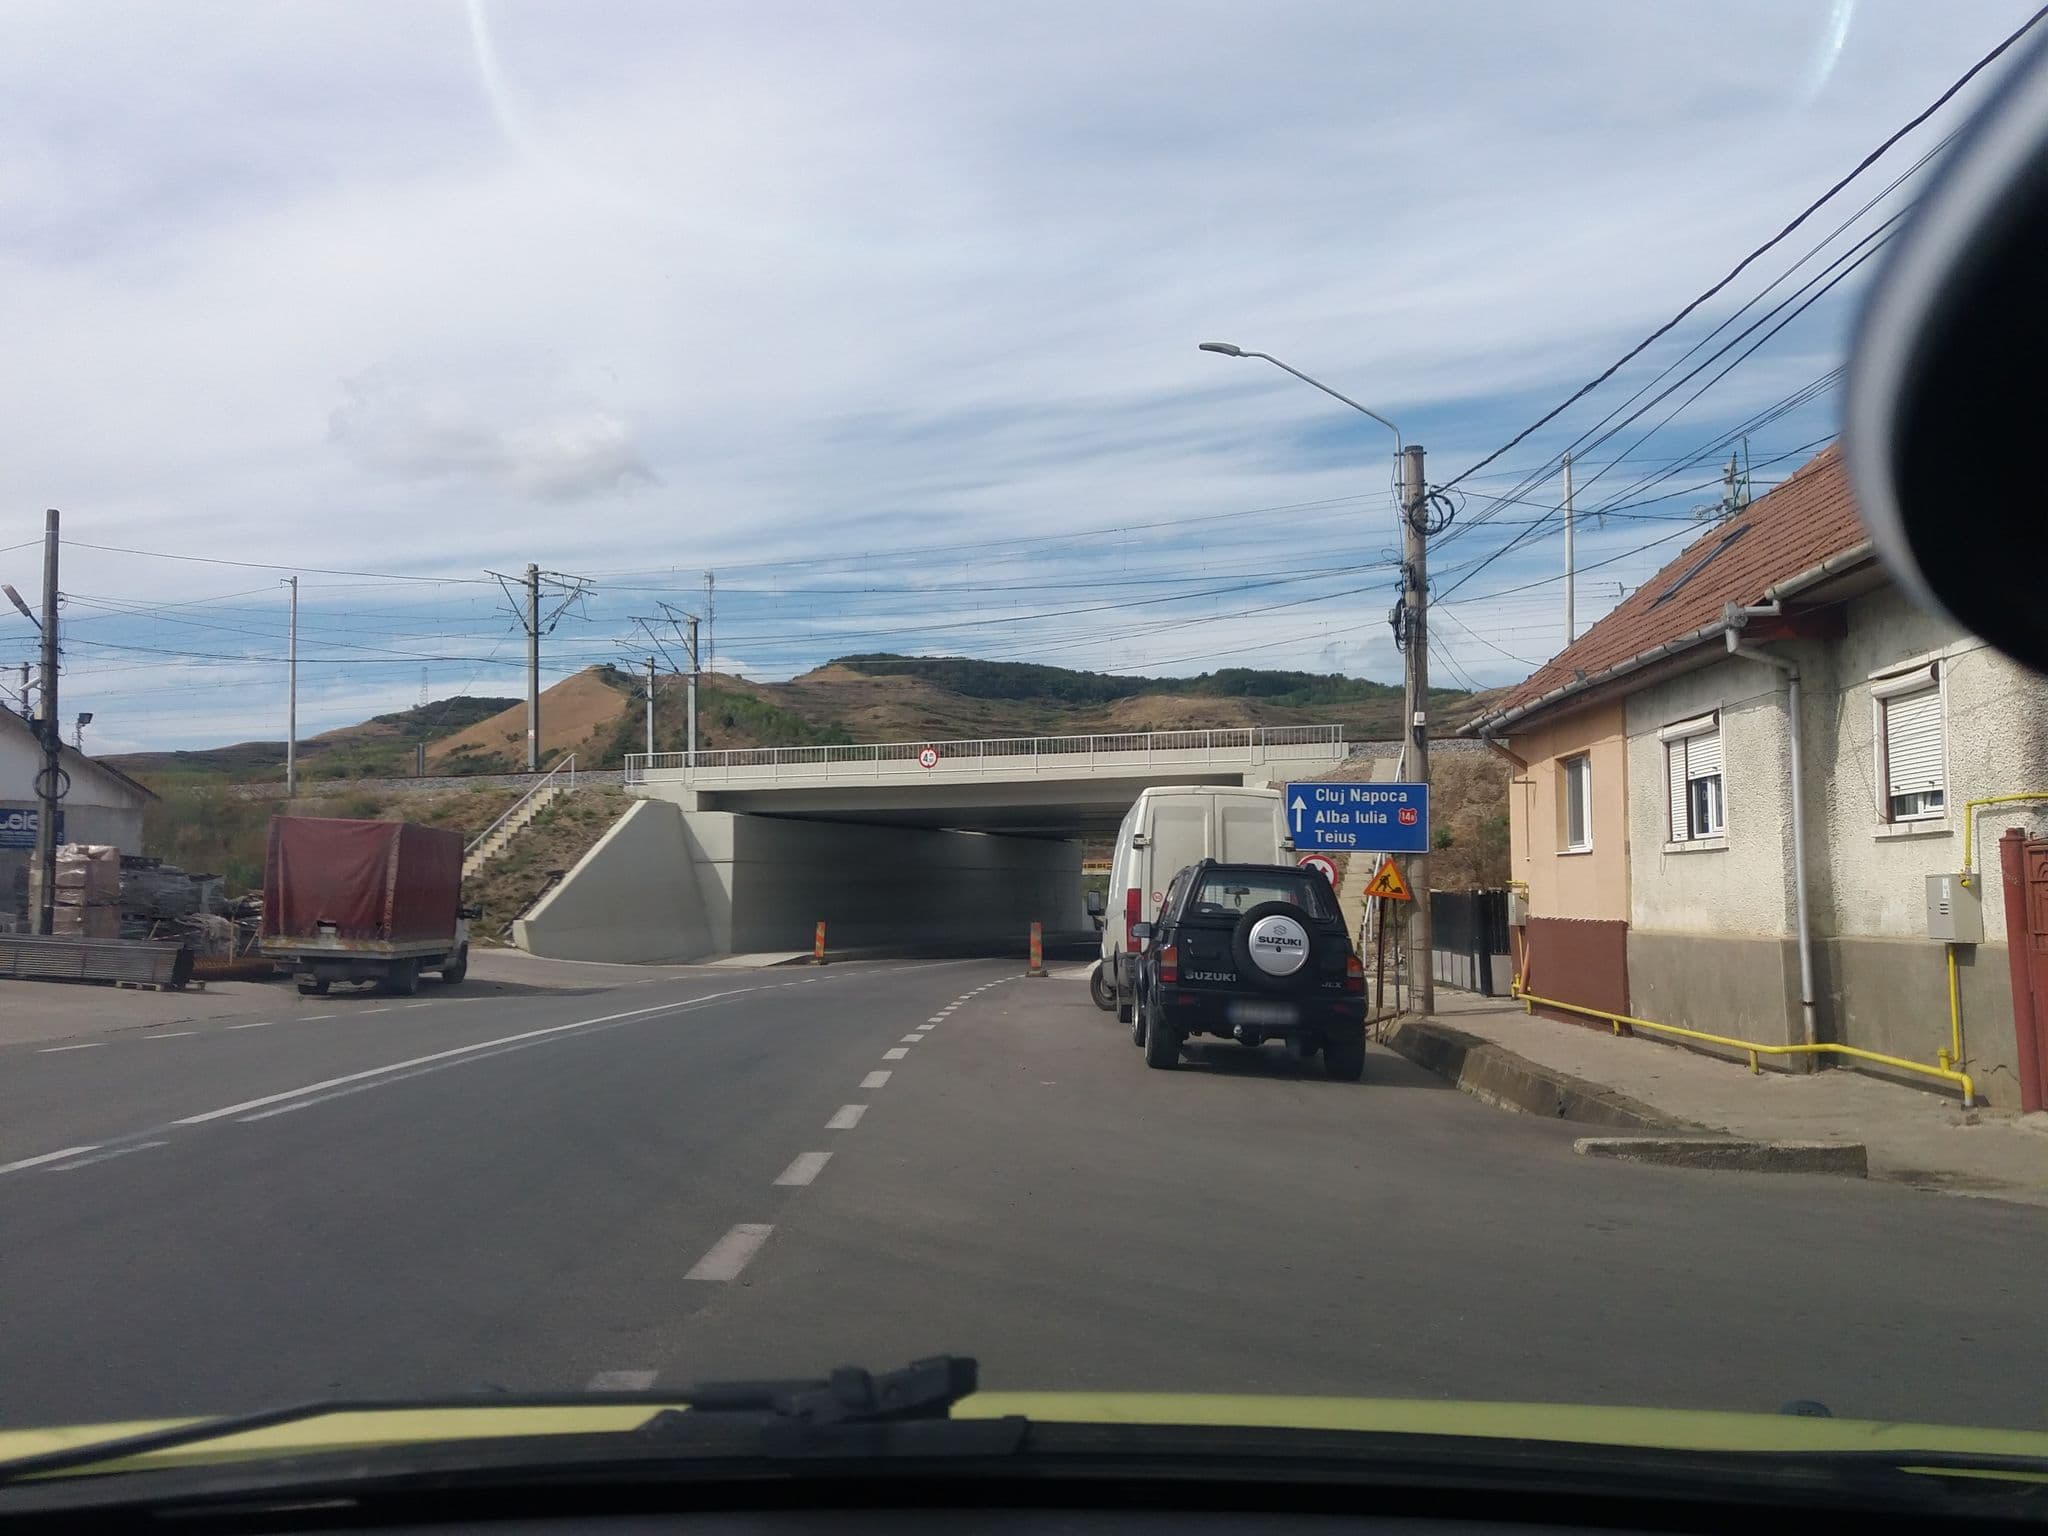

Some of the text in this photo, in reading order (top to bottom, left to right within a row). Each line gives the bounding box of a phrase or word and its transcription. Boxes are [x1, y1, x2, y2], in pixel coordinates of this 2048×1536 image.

[1315, 788, 1408, 806] Cluj Napoca
[1315, 810, 1388, 824] Alba Iulia
[1258, 935, 1302, 947] SUZUKI
[1185, 971, 1237, 982] SUZUKI
